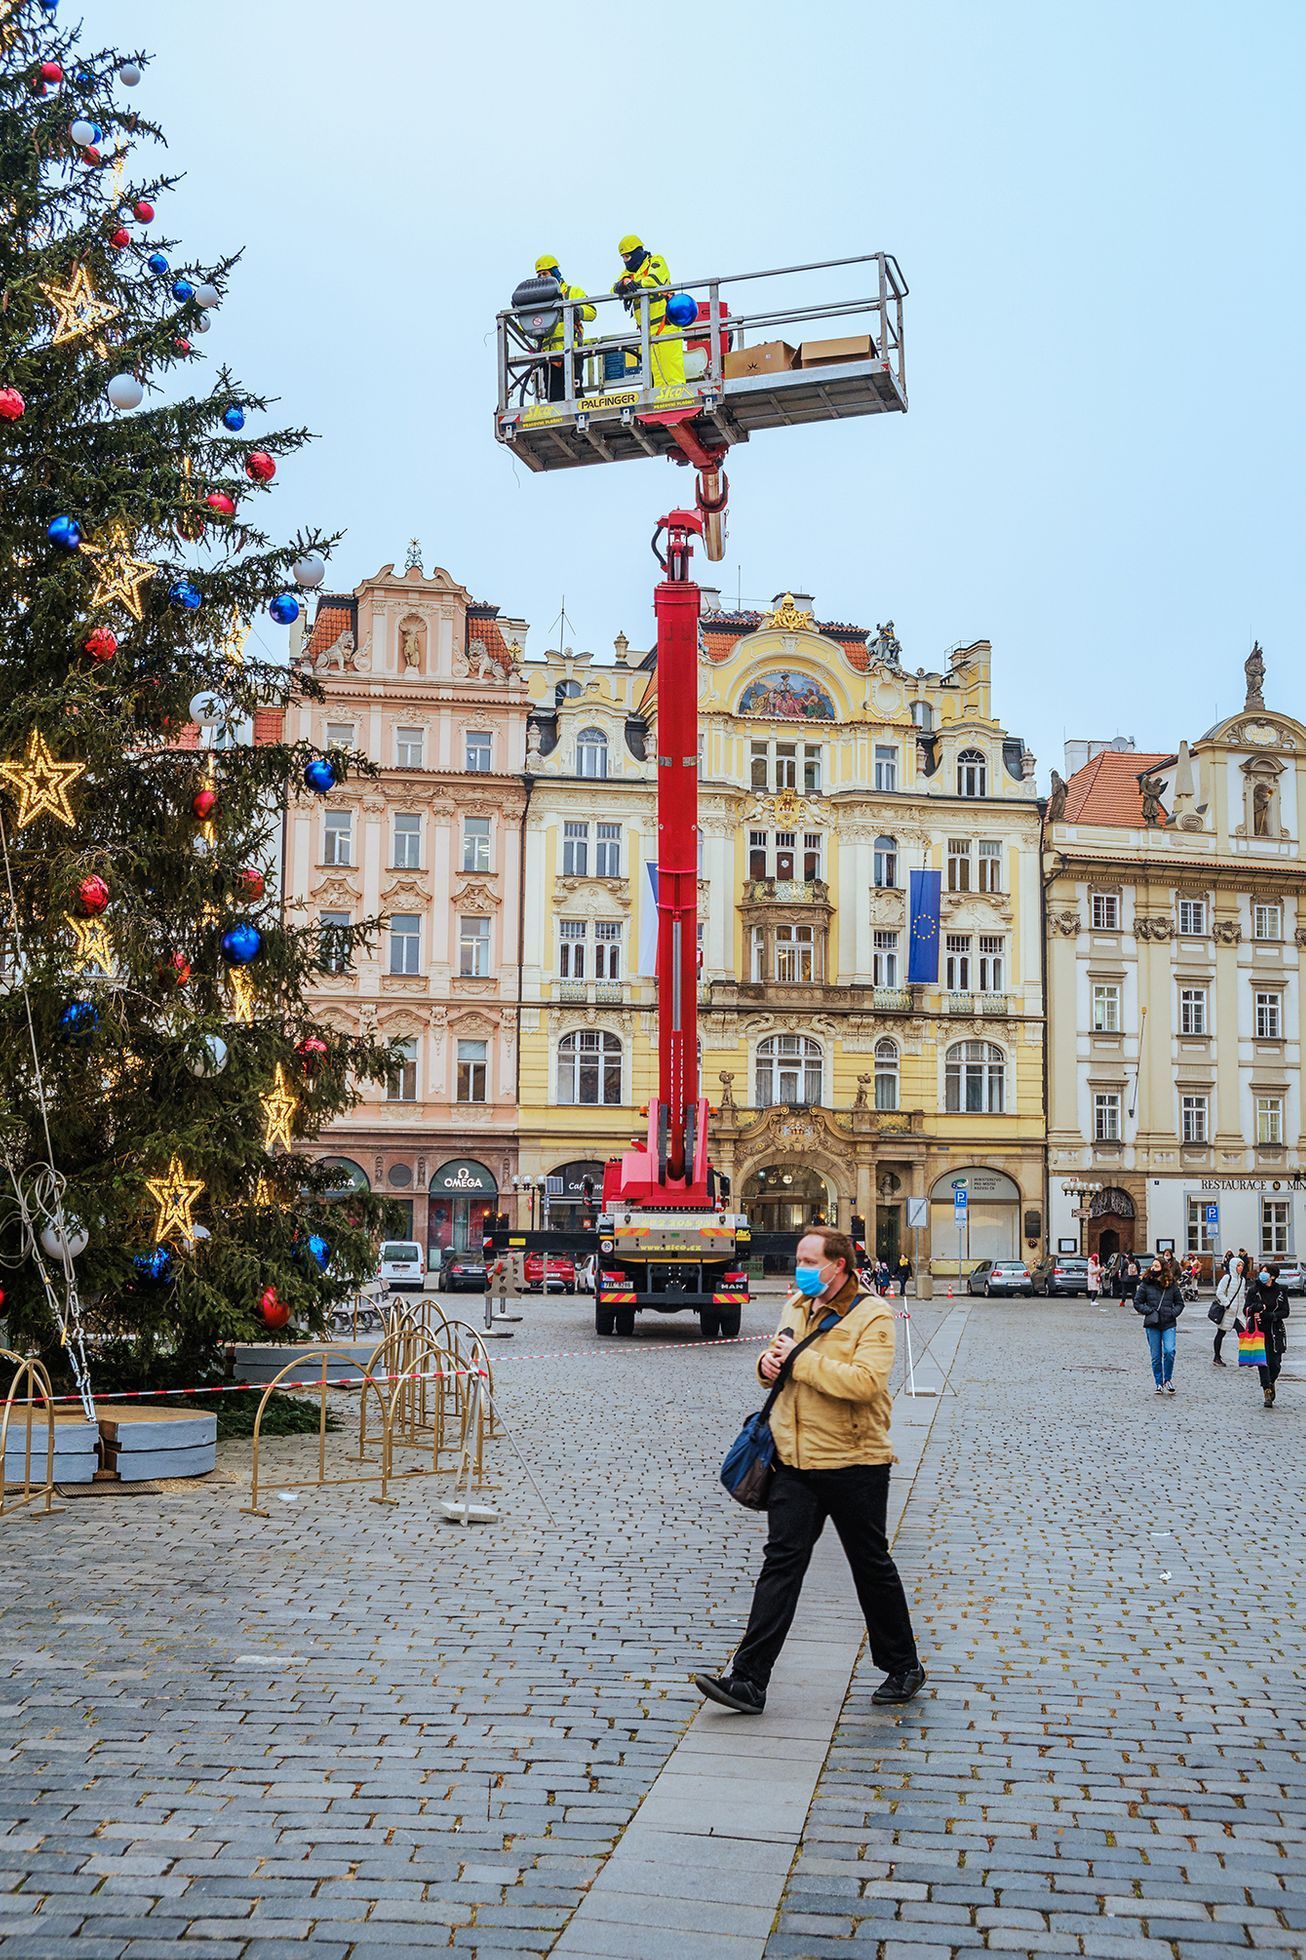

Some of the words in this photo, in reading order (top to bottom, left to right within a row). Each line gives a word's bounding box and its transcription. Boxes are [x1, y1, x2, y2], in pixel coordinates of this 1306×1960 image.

[581, 394, 635, 410] PALFINGER
[444, 1178, 483, 1188] OMEGA
[1201, 1180, 1266, 1190] RESTAURACE
[957, 1192, 965, 1203] P
[1208, 1208, 1216, 1218] P
